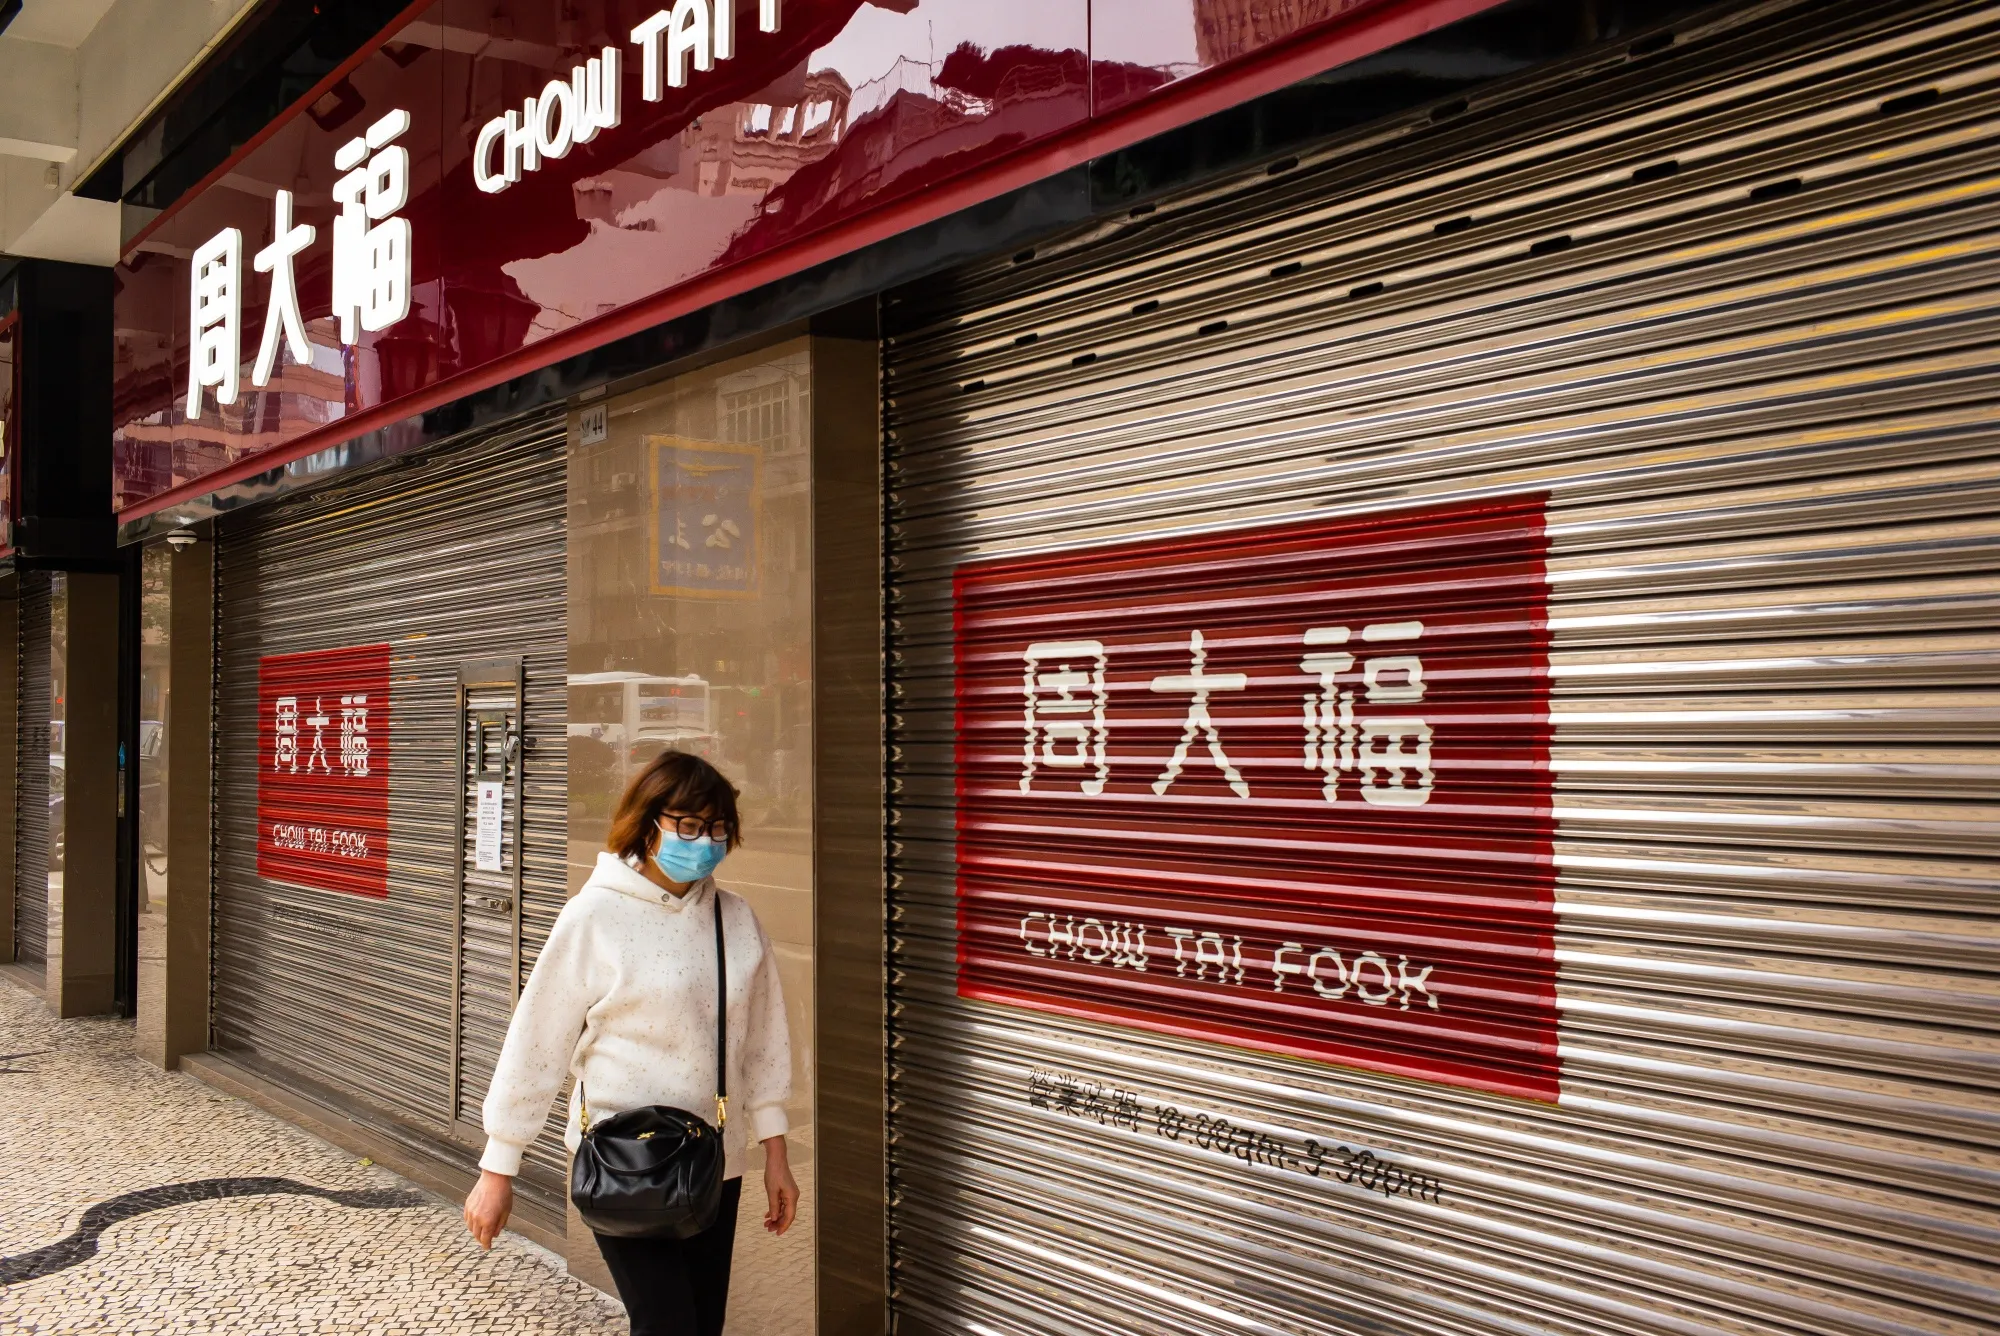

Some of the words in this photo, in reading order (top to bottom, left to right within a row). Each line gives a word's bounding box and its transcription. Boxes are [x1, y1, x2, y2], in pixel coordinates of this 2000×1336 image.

[473, 46, 622, 193] CHOW
[630, 0, 736, 102] TAI
[188, 108, 411, 420] 周大福
[274, 694, 371, 777] 周大福
[1019, 620, 1436, 807] 周大福
[273, 824, 307, 850] CHOW
[307, 827, 330, 852] TAI
[331, 830, 369, 859] FOOK
[1019, 911, 1149, 972] CHOW
[1164, 927, 1245, 986] TAI
[1272, 942, 1439, 1011] FOOK
[1028, 1067, 1142, 1133] 營業時間
